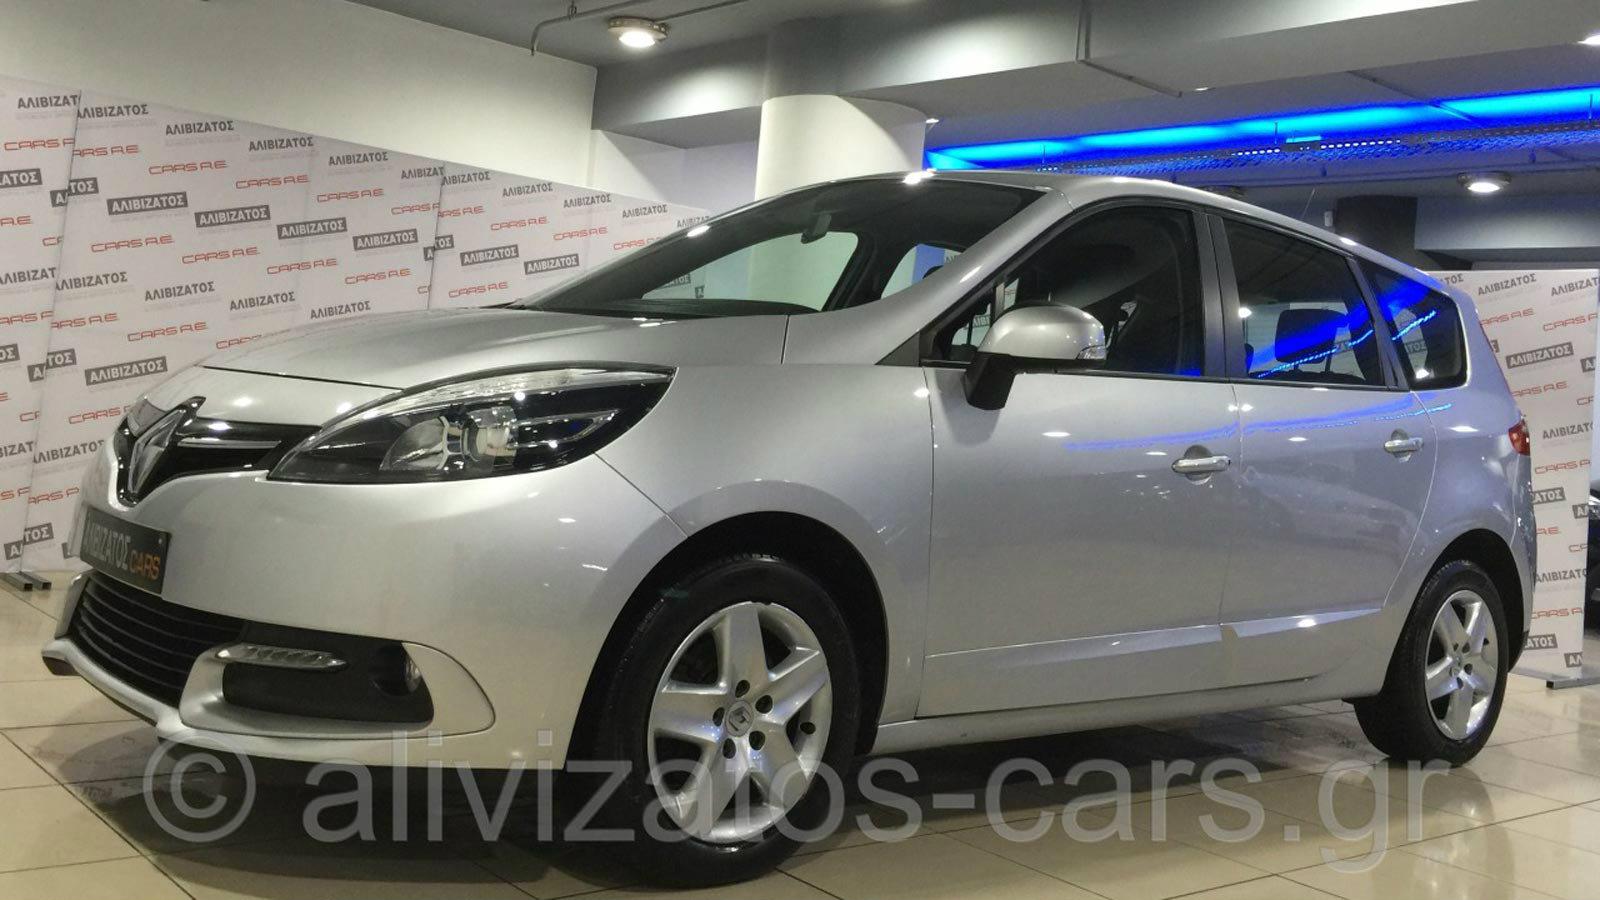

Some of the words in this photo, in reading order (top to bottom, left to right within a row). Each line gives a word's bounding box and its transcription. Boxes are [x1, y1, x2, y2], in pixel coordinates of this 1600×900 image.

[18, 95, 80, 109] ΑΛΙΒΙΖΑΤ
[165, 120, 234, 136] ΑΛΙΒΙΖΑΤΟΣ
[249, 137, 314, 152] ΑΛΙΒΙΖΑΤΟΣ
[329, 152, 389, 167] ΑΛΙΒΙΖΑΤΟΣ
[440, 171, 491, 186] ΛΙΒΙΖΑΤΟΣ
[502, 182, 553, 198] ΑΛΙΒΙΖΑΤΟΣ
[111, 194, 185, 213] ΑΛΙΒΙΖΑΤΟΣ
[199, 206, 268, 225] ΑΛΙΒΙΖΑΤΟΣ
[281, 219, 346, 238] ΑΛΙΒΙΖΑΤΟΣ
[356, 231, 416, 248] ΑΛΙΒΙΖΑΤΟΣ
[464, 246, 517, 264] ΑΛΙΒΙΖΑΤΟΣ
[527, 256, 578, 273] ΑΛΙΒΙΖΑΤΟΣ
[145, 281, 215, 302] ΑΛΙΒΙΖΑΤΟΣ
[1478, 273, 1537, 296] ΑΛΙΒΙΖΑΤΟΣ
[229, 291, 296, 311] ΑΛΙΒΙΖΑΤΟΣ
[310, 300, 371, 319] ΑΛΙΒΙΖΑΤΟΣ
[1509, 344, 1572, 367] ΑΛΙΒΙΖΑΤΟΣ
[90, 359, 164, 383] ΑΛΙΒΙΖΑΤΟΣ
